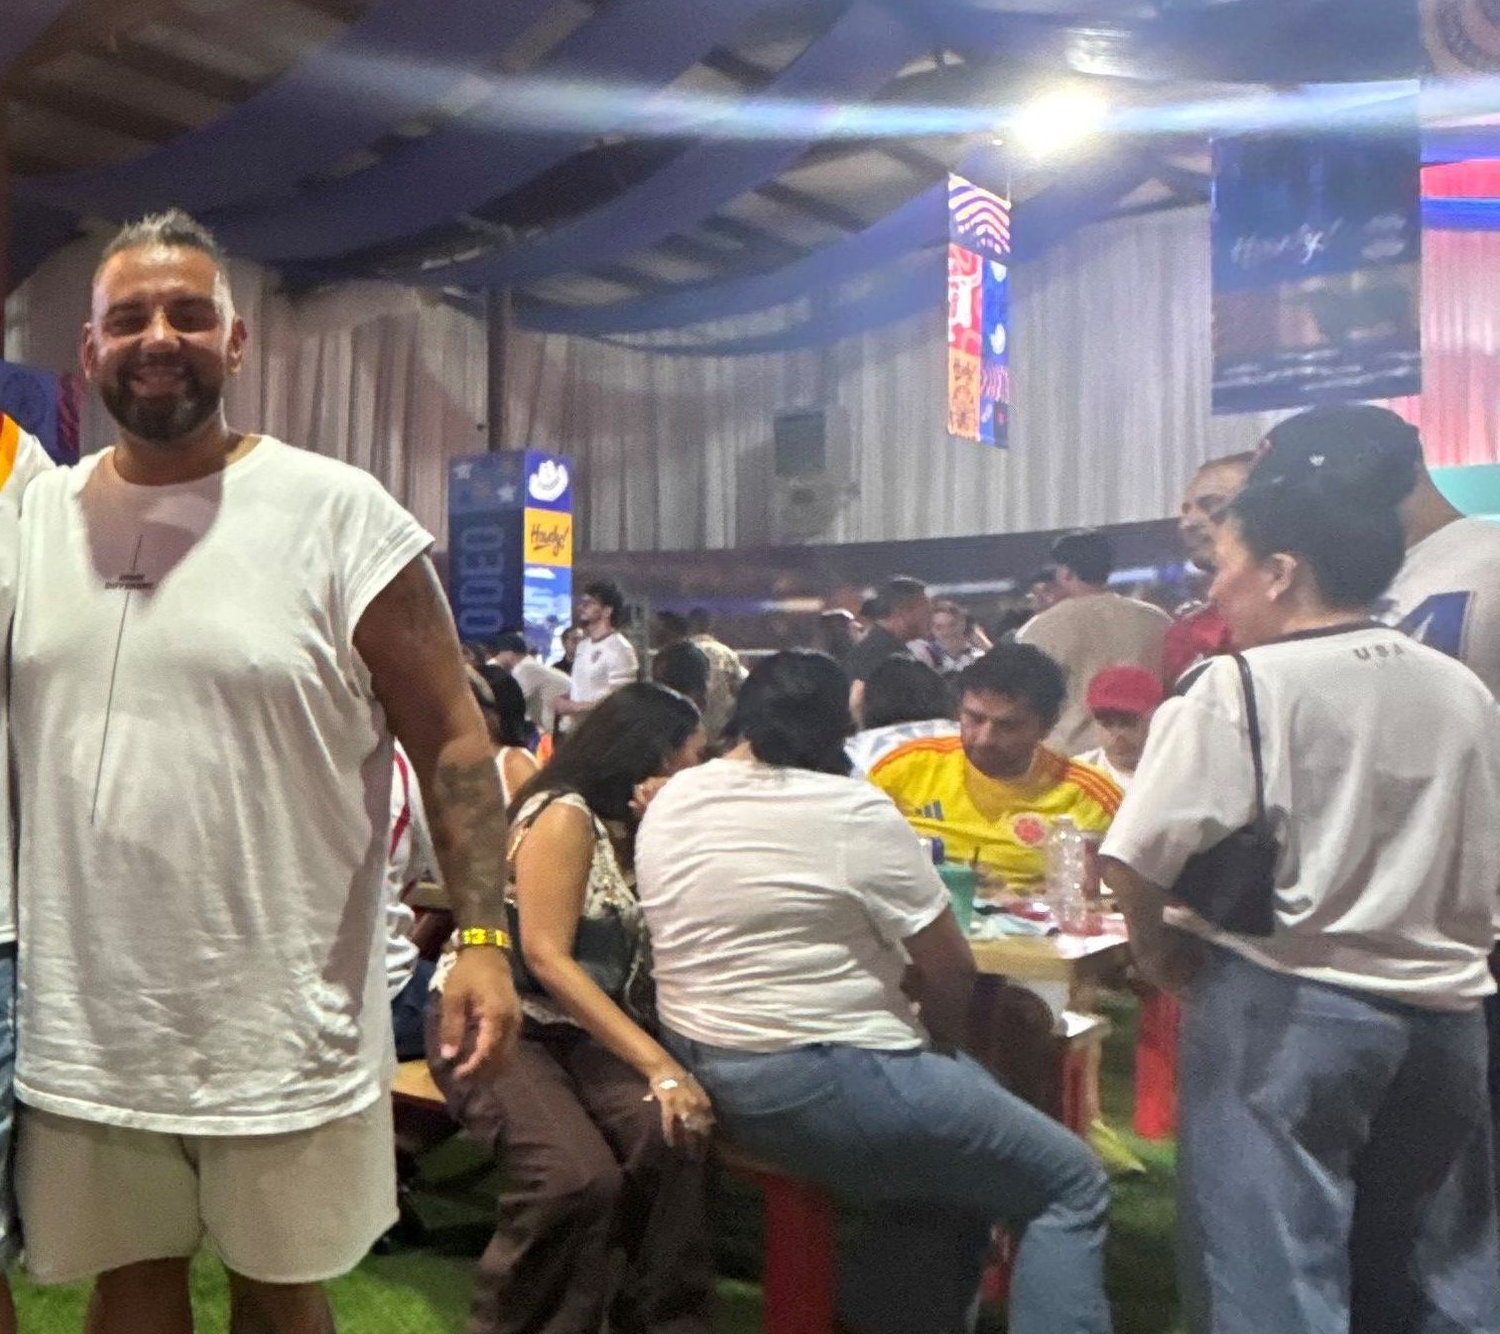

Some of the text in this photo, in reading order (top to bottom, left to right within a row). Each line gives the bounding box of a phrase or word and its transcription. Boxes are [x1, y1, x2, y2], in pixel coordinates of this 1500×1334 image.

[531, 524, 570, 557] Howdy!
[458, 526, 504, 635] ODEO
[1354, 643, 1404, 661] USA
